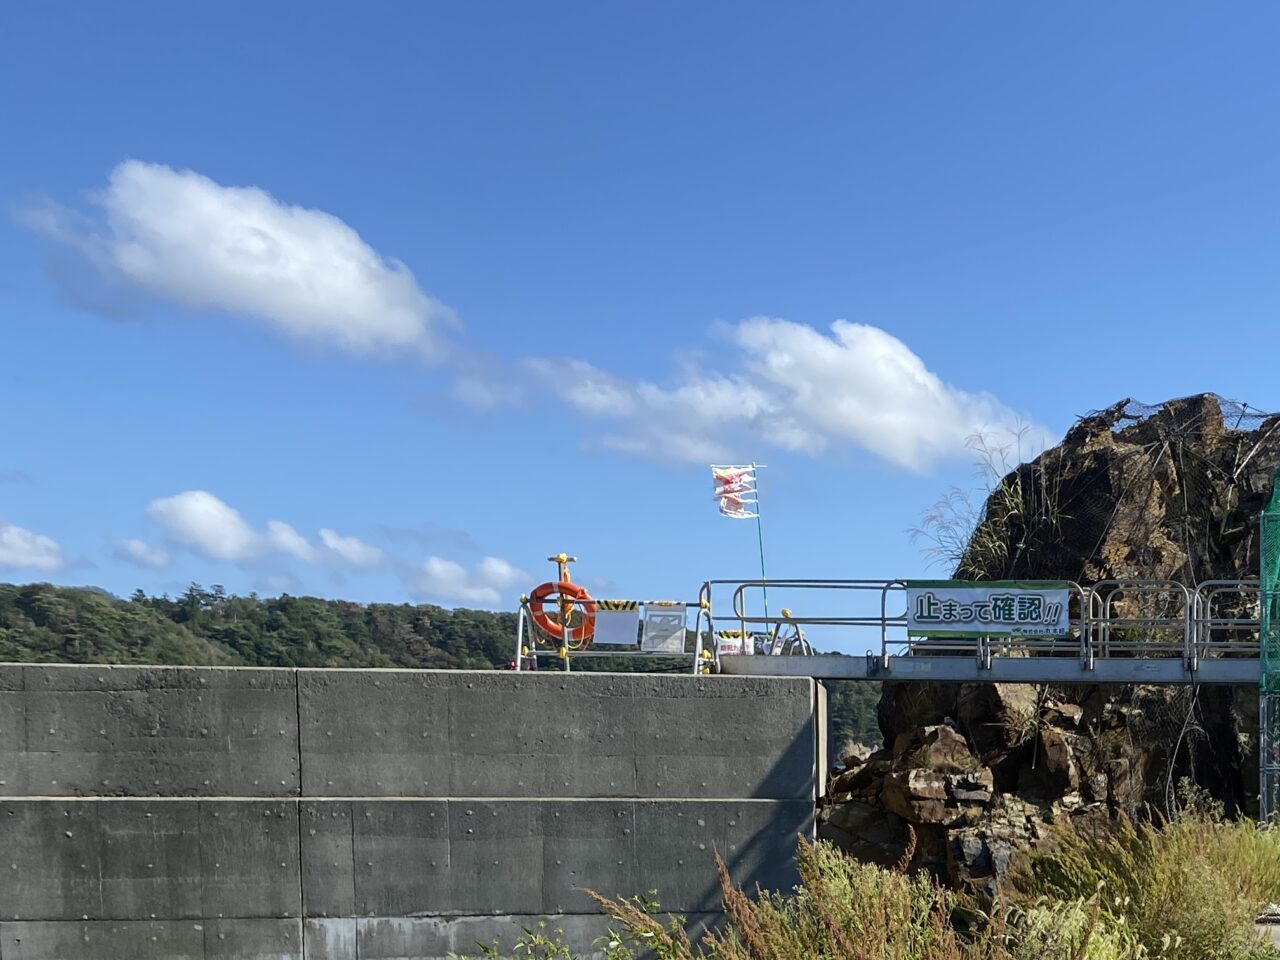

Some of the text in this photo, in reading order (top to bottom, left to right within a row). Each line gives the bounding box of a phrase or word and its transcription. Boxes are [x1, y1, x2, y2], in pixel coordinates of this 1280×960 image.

[915, 593, 1061, 623] 止まって確認!!
